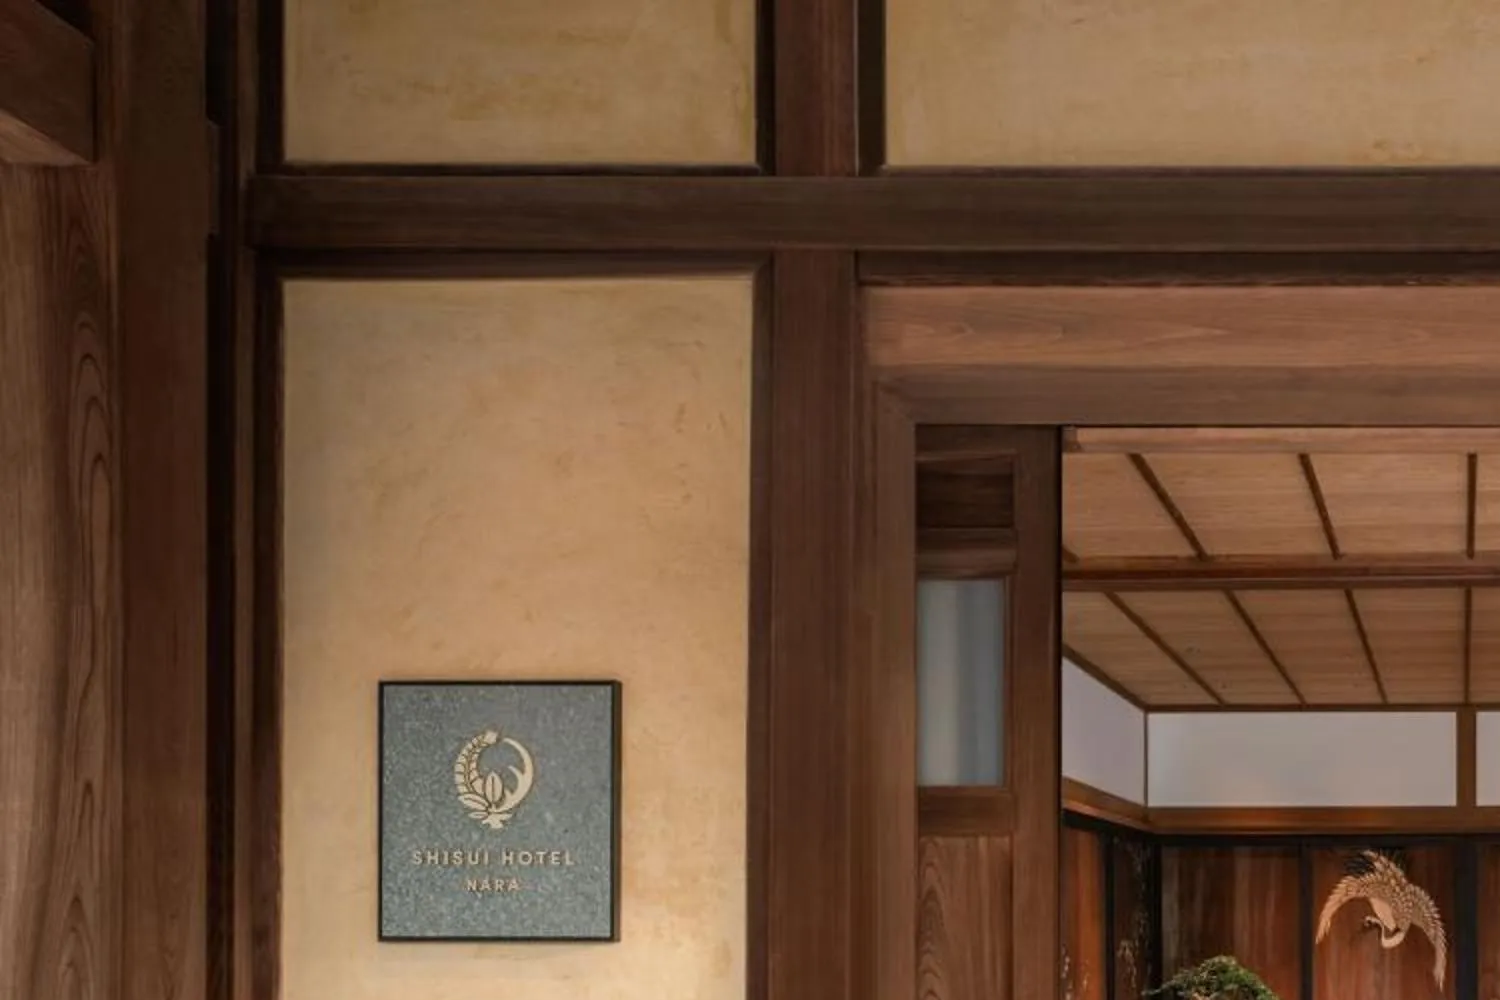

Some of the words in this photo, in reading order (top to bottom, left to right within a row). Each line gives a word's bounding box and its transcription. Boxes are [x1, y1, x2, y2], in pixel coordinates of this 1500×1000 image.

[412, 850, 490, 866] SHISUI
[501, 850, 576, 866] HOTEL
[466, 878, 521, 892] NARA
